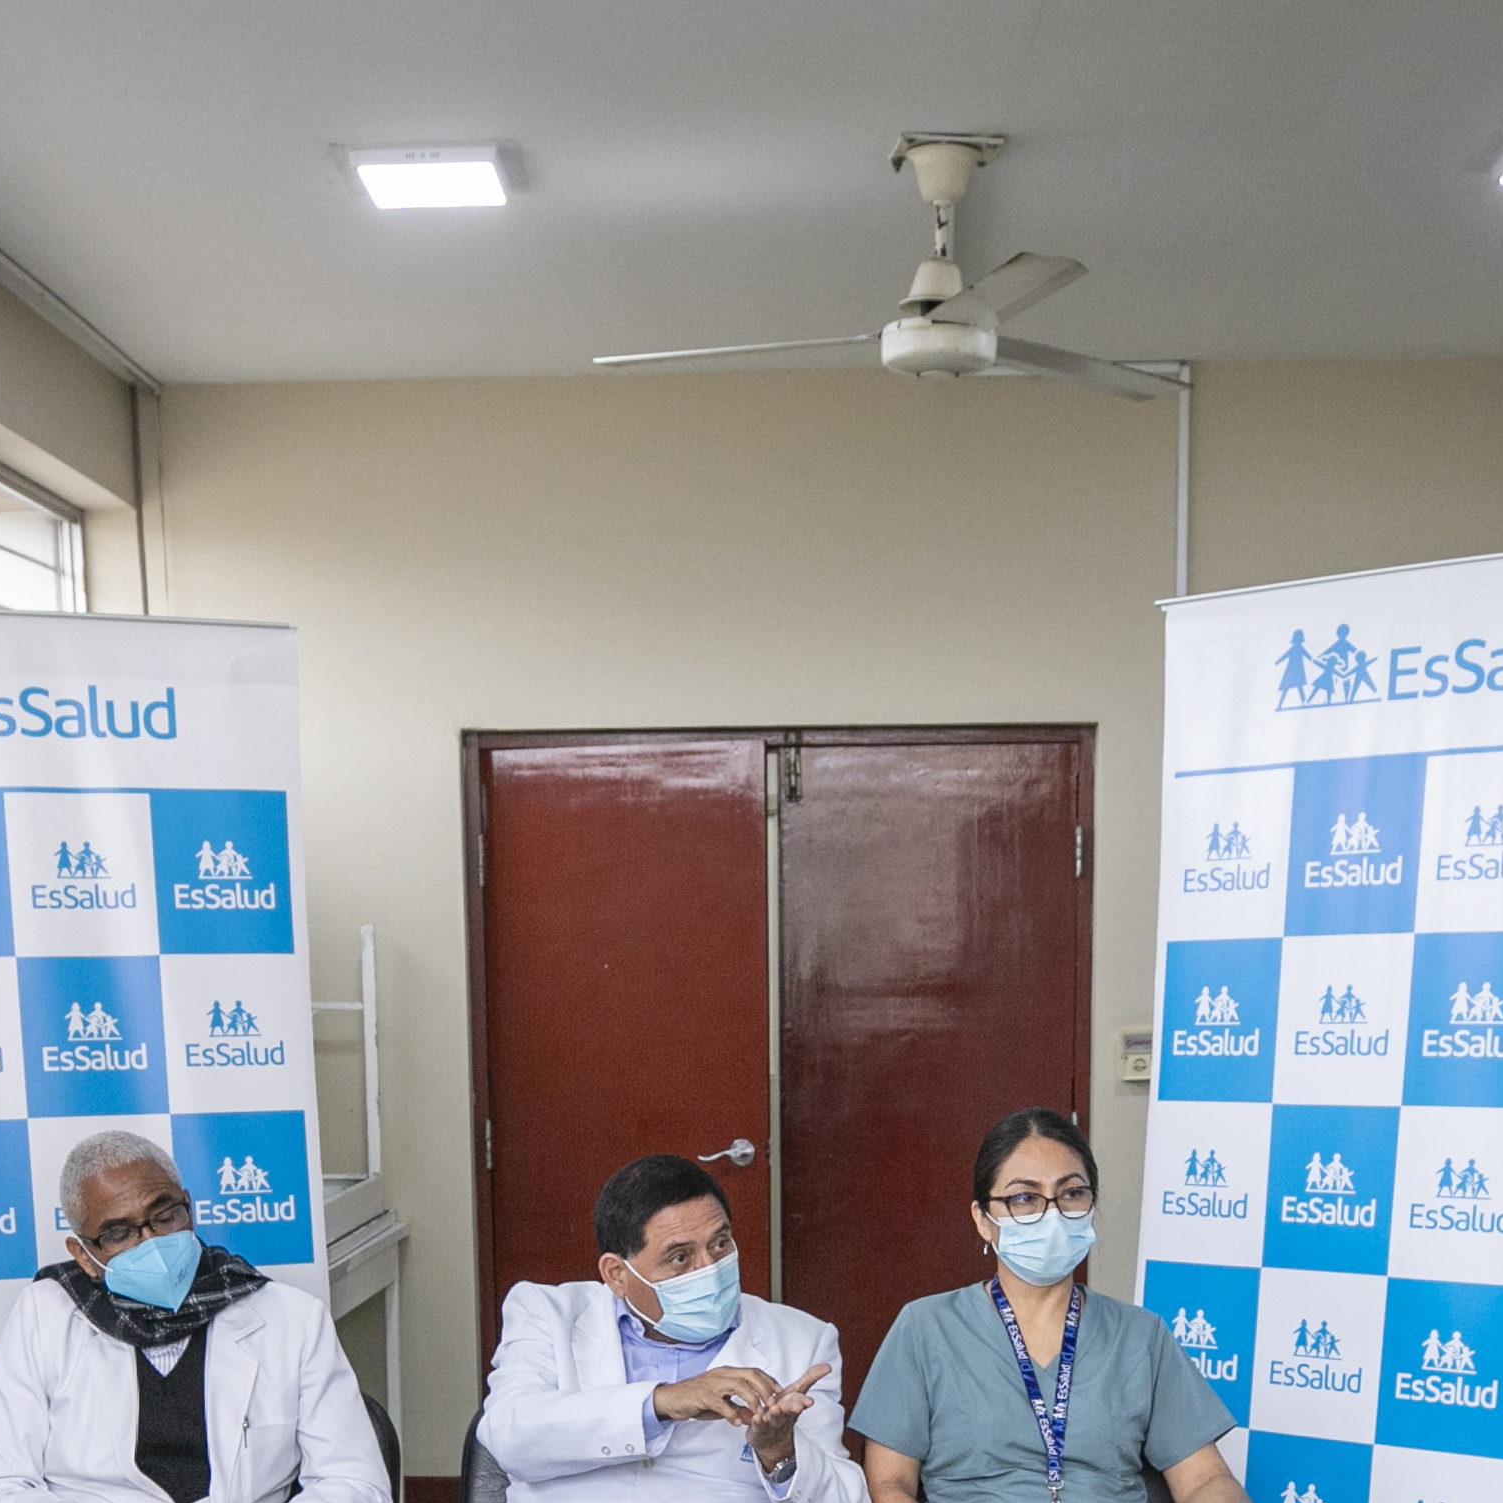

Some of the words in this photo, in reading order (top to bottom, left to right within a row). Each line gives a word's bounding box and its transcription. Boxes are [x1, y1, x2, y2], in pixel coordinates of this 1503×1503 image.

[1183, 862, 1271, 893] EsSalud
[1304, 854, 1403, 889] EsSalud
[31, 882, 137, 910] EsSalud
[173, 881, 277, 911] EsSalud
[42, 1042, 149, 1073] EsSalud
[185, 1040, 285, 1068] EsSalud
[1172, 1028, 1260, 1058] EsSalud
[1294, 1028, 1390, 1057] EsSalud
[195, 1194, 297, 1226] EsSalud
[1161, 1190, 1249, 1221] EsSalud
[1280, 1195, 1378, 1230] EsSalud
[1269, 1360, 1363, 1395] EsSalud
[1395, 1372, 1499, 1411] EsSalud
